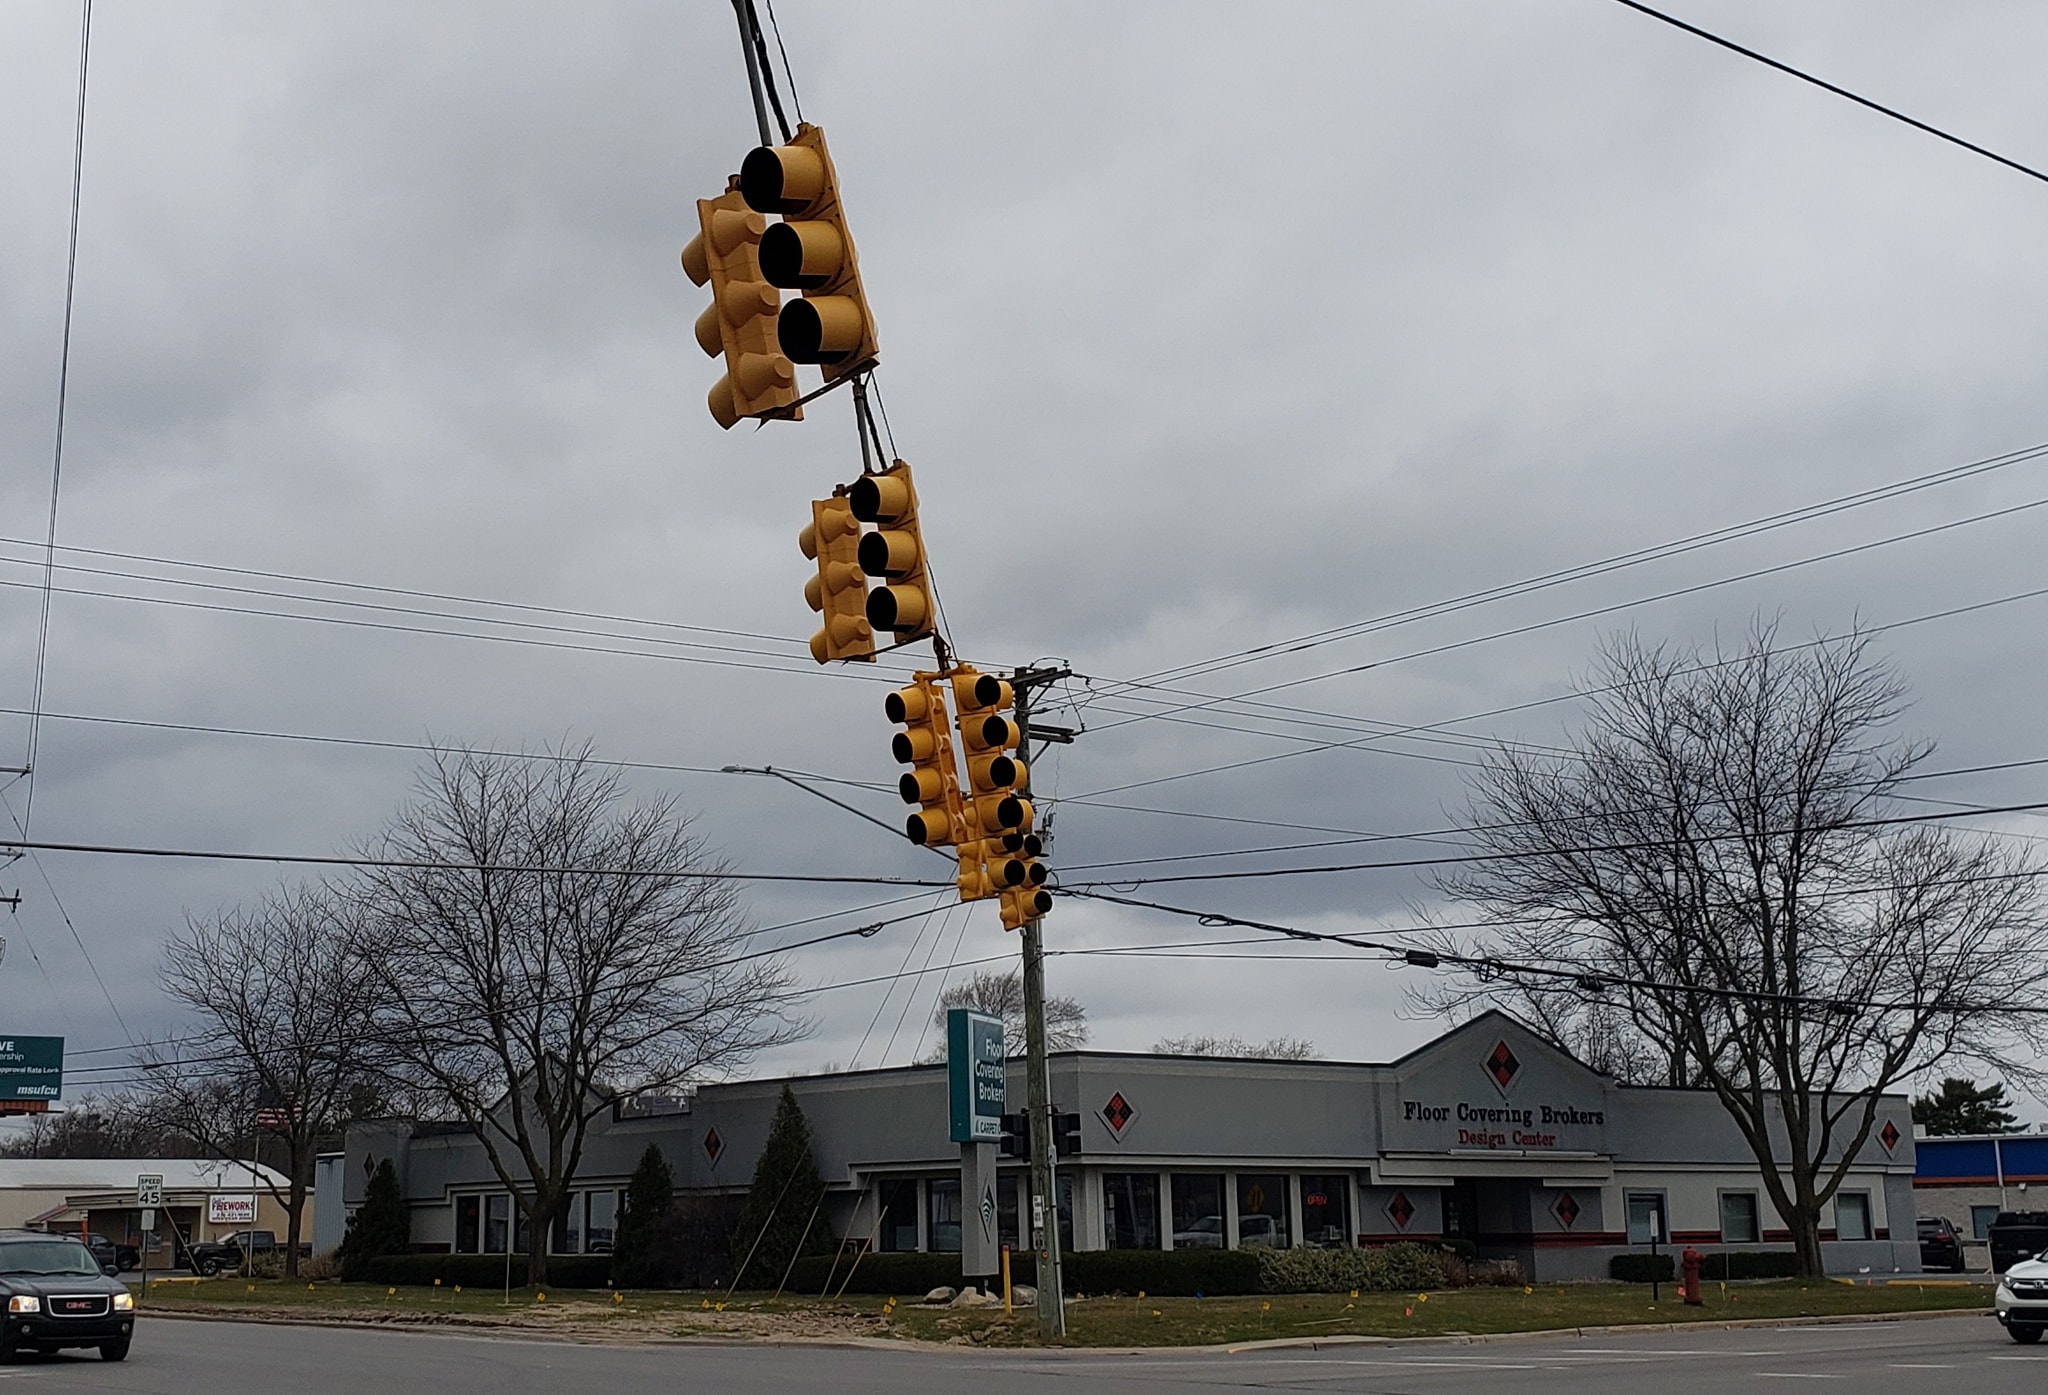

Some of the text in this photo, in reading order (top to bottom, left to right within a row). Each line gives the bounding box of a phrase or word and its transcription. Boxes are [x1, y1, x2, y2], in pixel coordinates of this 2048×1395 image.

[985, 1038, 1003, 1058] Floor
[975, 1059, 1004, 1083] Covering
[17, 1085, 58, 1095] msufcu
[980, 1081, 1004, 1102] Brokers
[1403, 1101, 1604, 1128] Floor Covering Brokers
[1458, 1128, 1556, 1149] Design Center
[140, 1192, 160, 1204] 45
[66, 1301, 92, 1309] GMC
